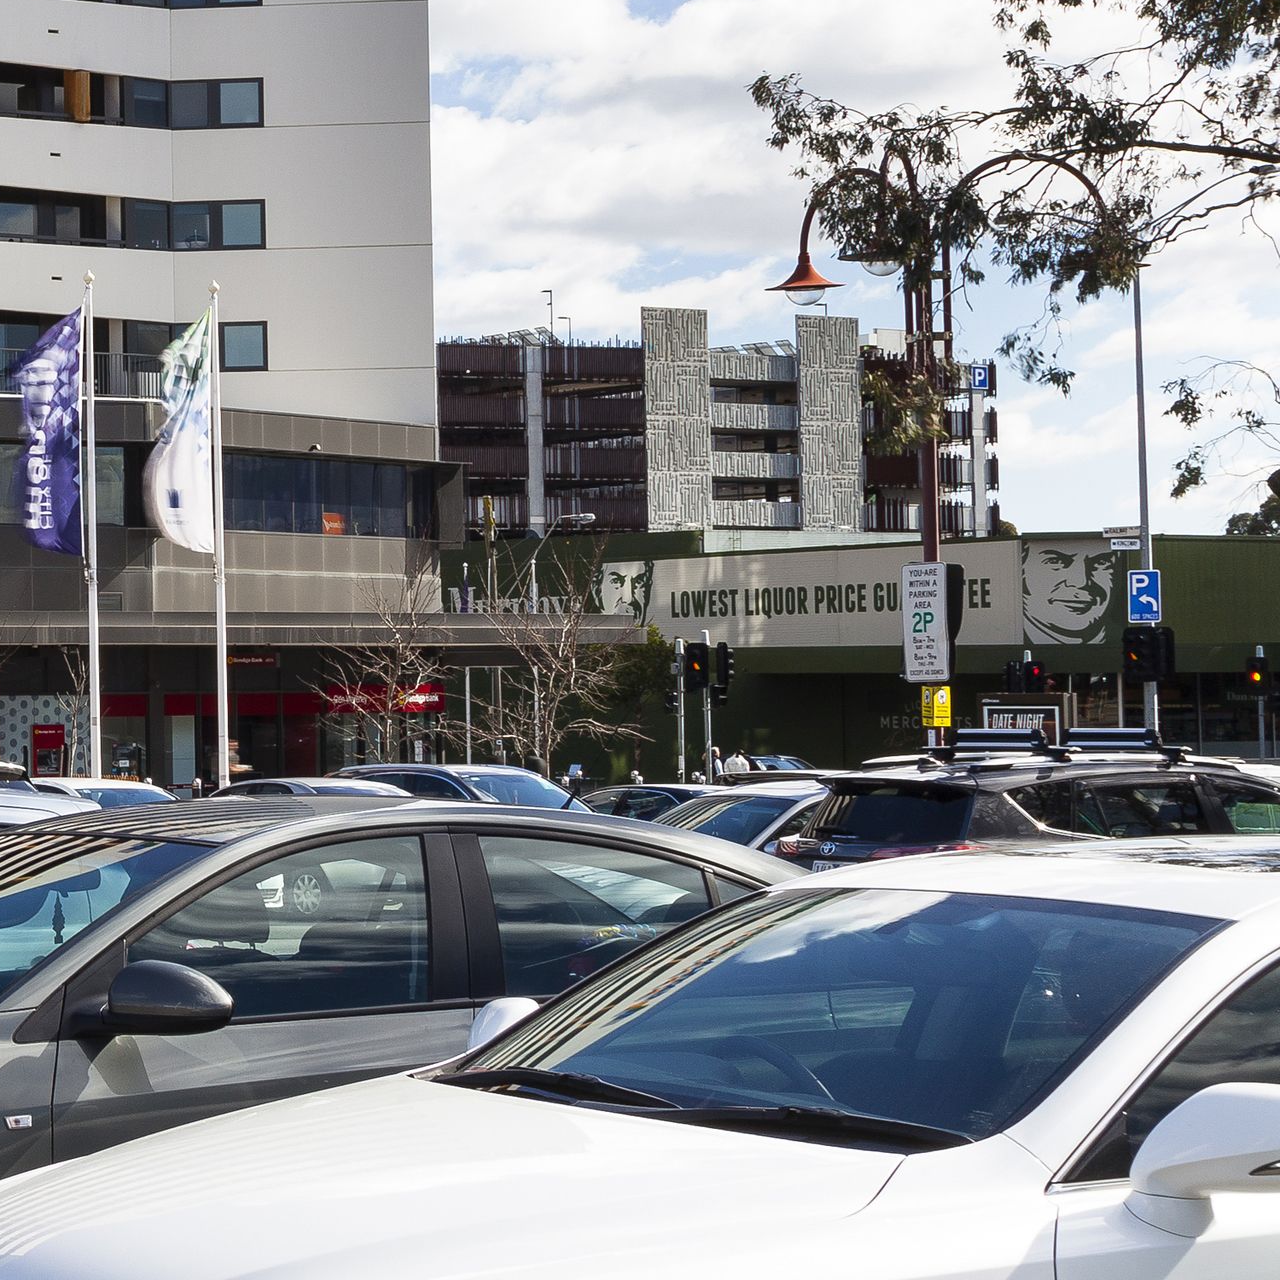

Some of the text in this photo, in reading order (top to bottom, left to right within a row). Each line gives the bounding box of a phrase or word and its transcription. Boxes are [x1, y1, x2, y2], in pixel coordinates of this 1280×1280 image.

[975, 368, 985, 386] P
[909, 568, 938, 578] YOU ARE
[909, 579, 938, 588] WITHIN A
[1131, 574, 1150, 596] P
[671, 590, 739, 619] LOWEST
[744, 586, 809, 619] LIQUOR
[814, 584, 867, 614] PRICE
[909, 590, 937, 598] PARKING
[914, 601, 932, 609] AREA
[912, 612, 934, 633] 2P
[880, 715, 972, 730] MERCTS
[992, 714, 1045, 729] DATE NIGHT
